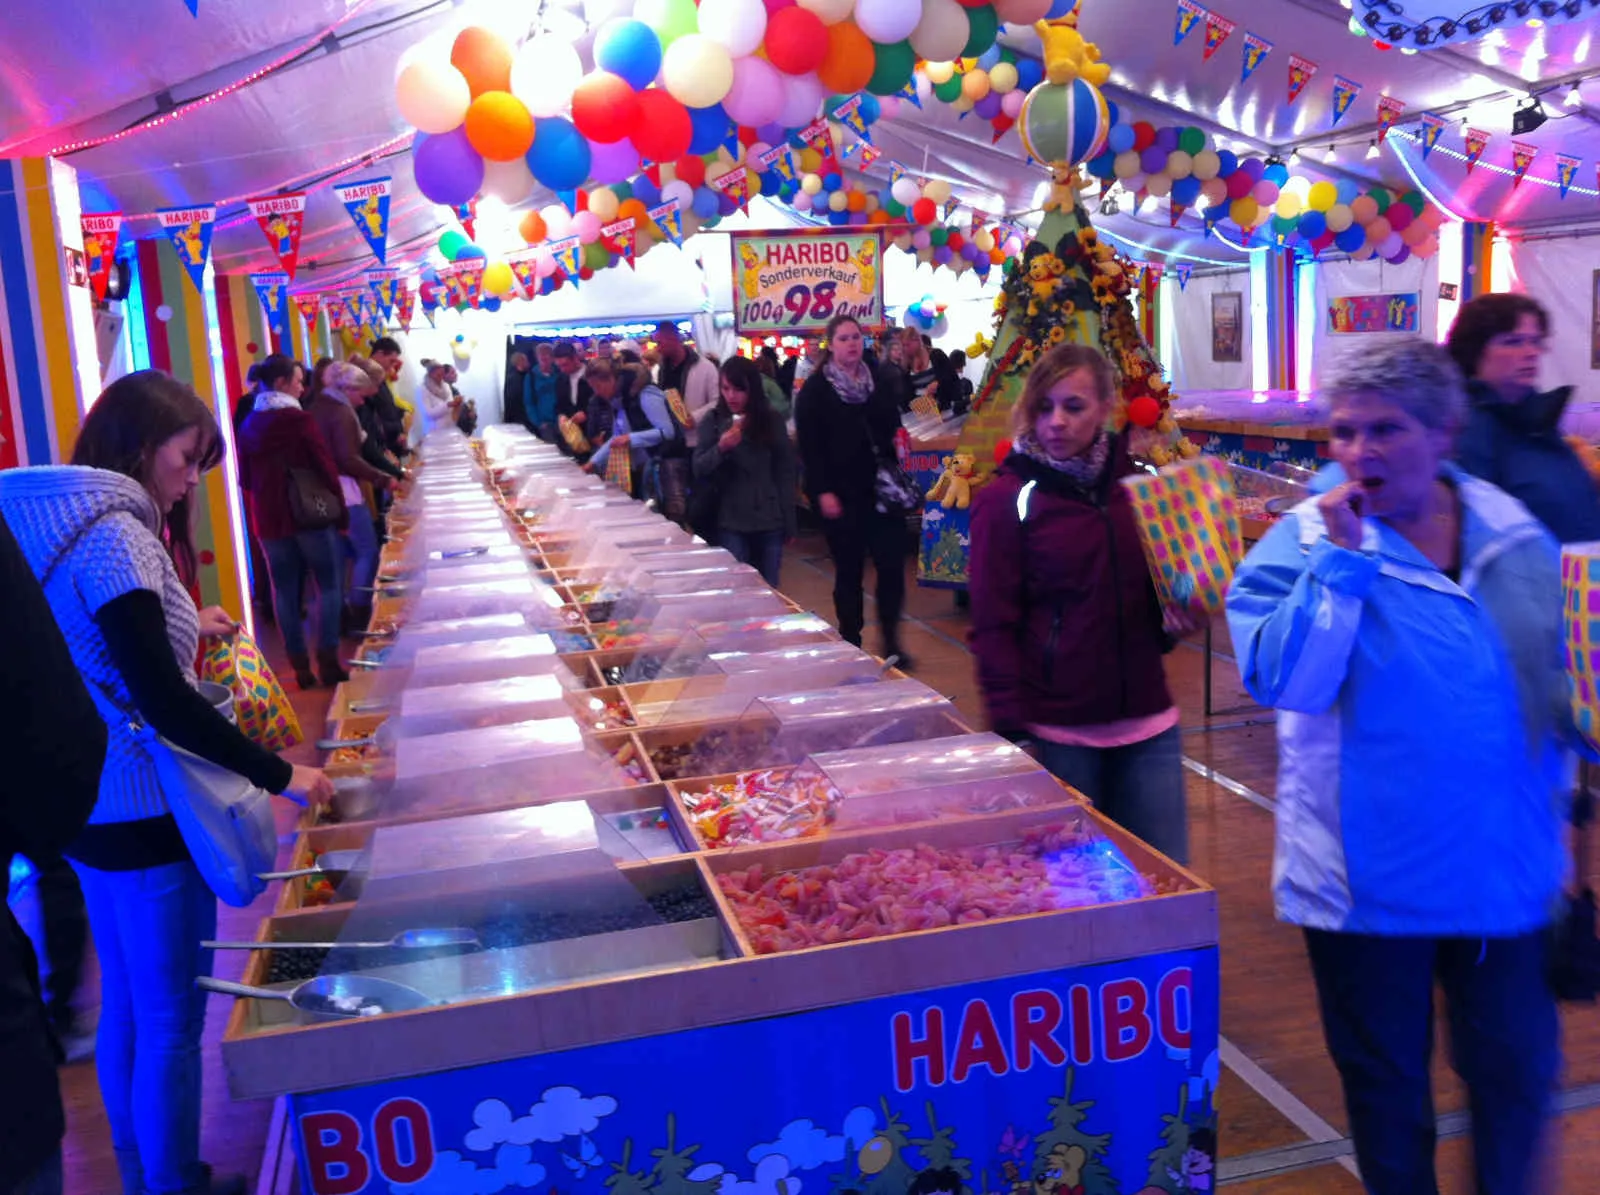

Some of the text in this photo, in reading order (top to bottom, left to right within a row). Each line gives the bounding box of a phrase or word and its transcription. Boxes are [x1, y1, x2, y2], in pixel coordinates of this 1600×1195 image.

[344, 184, 386, 201] HARIBO
[165, 210, 209, 225] HARIBO
[255, 199, 300, 215] HARIBO
[766, 241, 849, 266] HARIBO
[759, 265, 858, 289] Sonderverkauf
[743, 300, 784, 324] 100g
[784, 281, 838, 326] 98
[890, 966, 1192, 1093] HARIBO
[298, 1096, 434, 1195] BO
